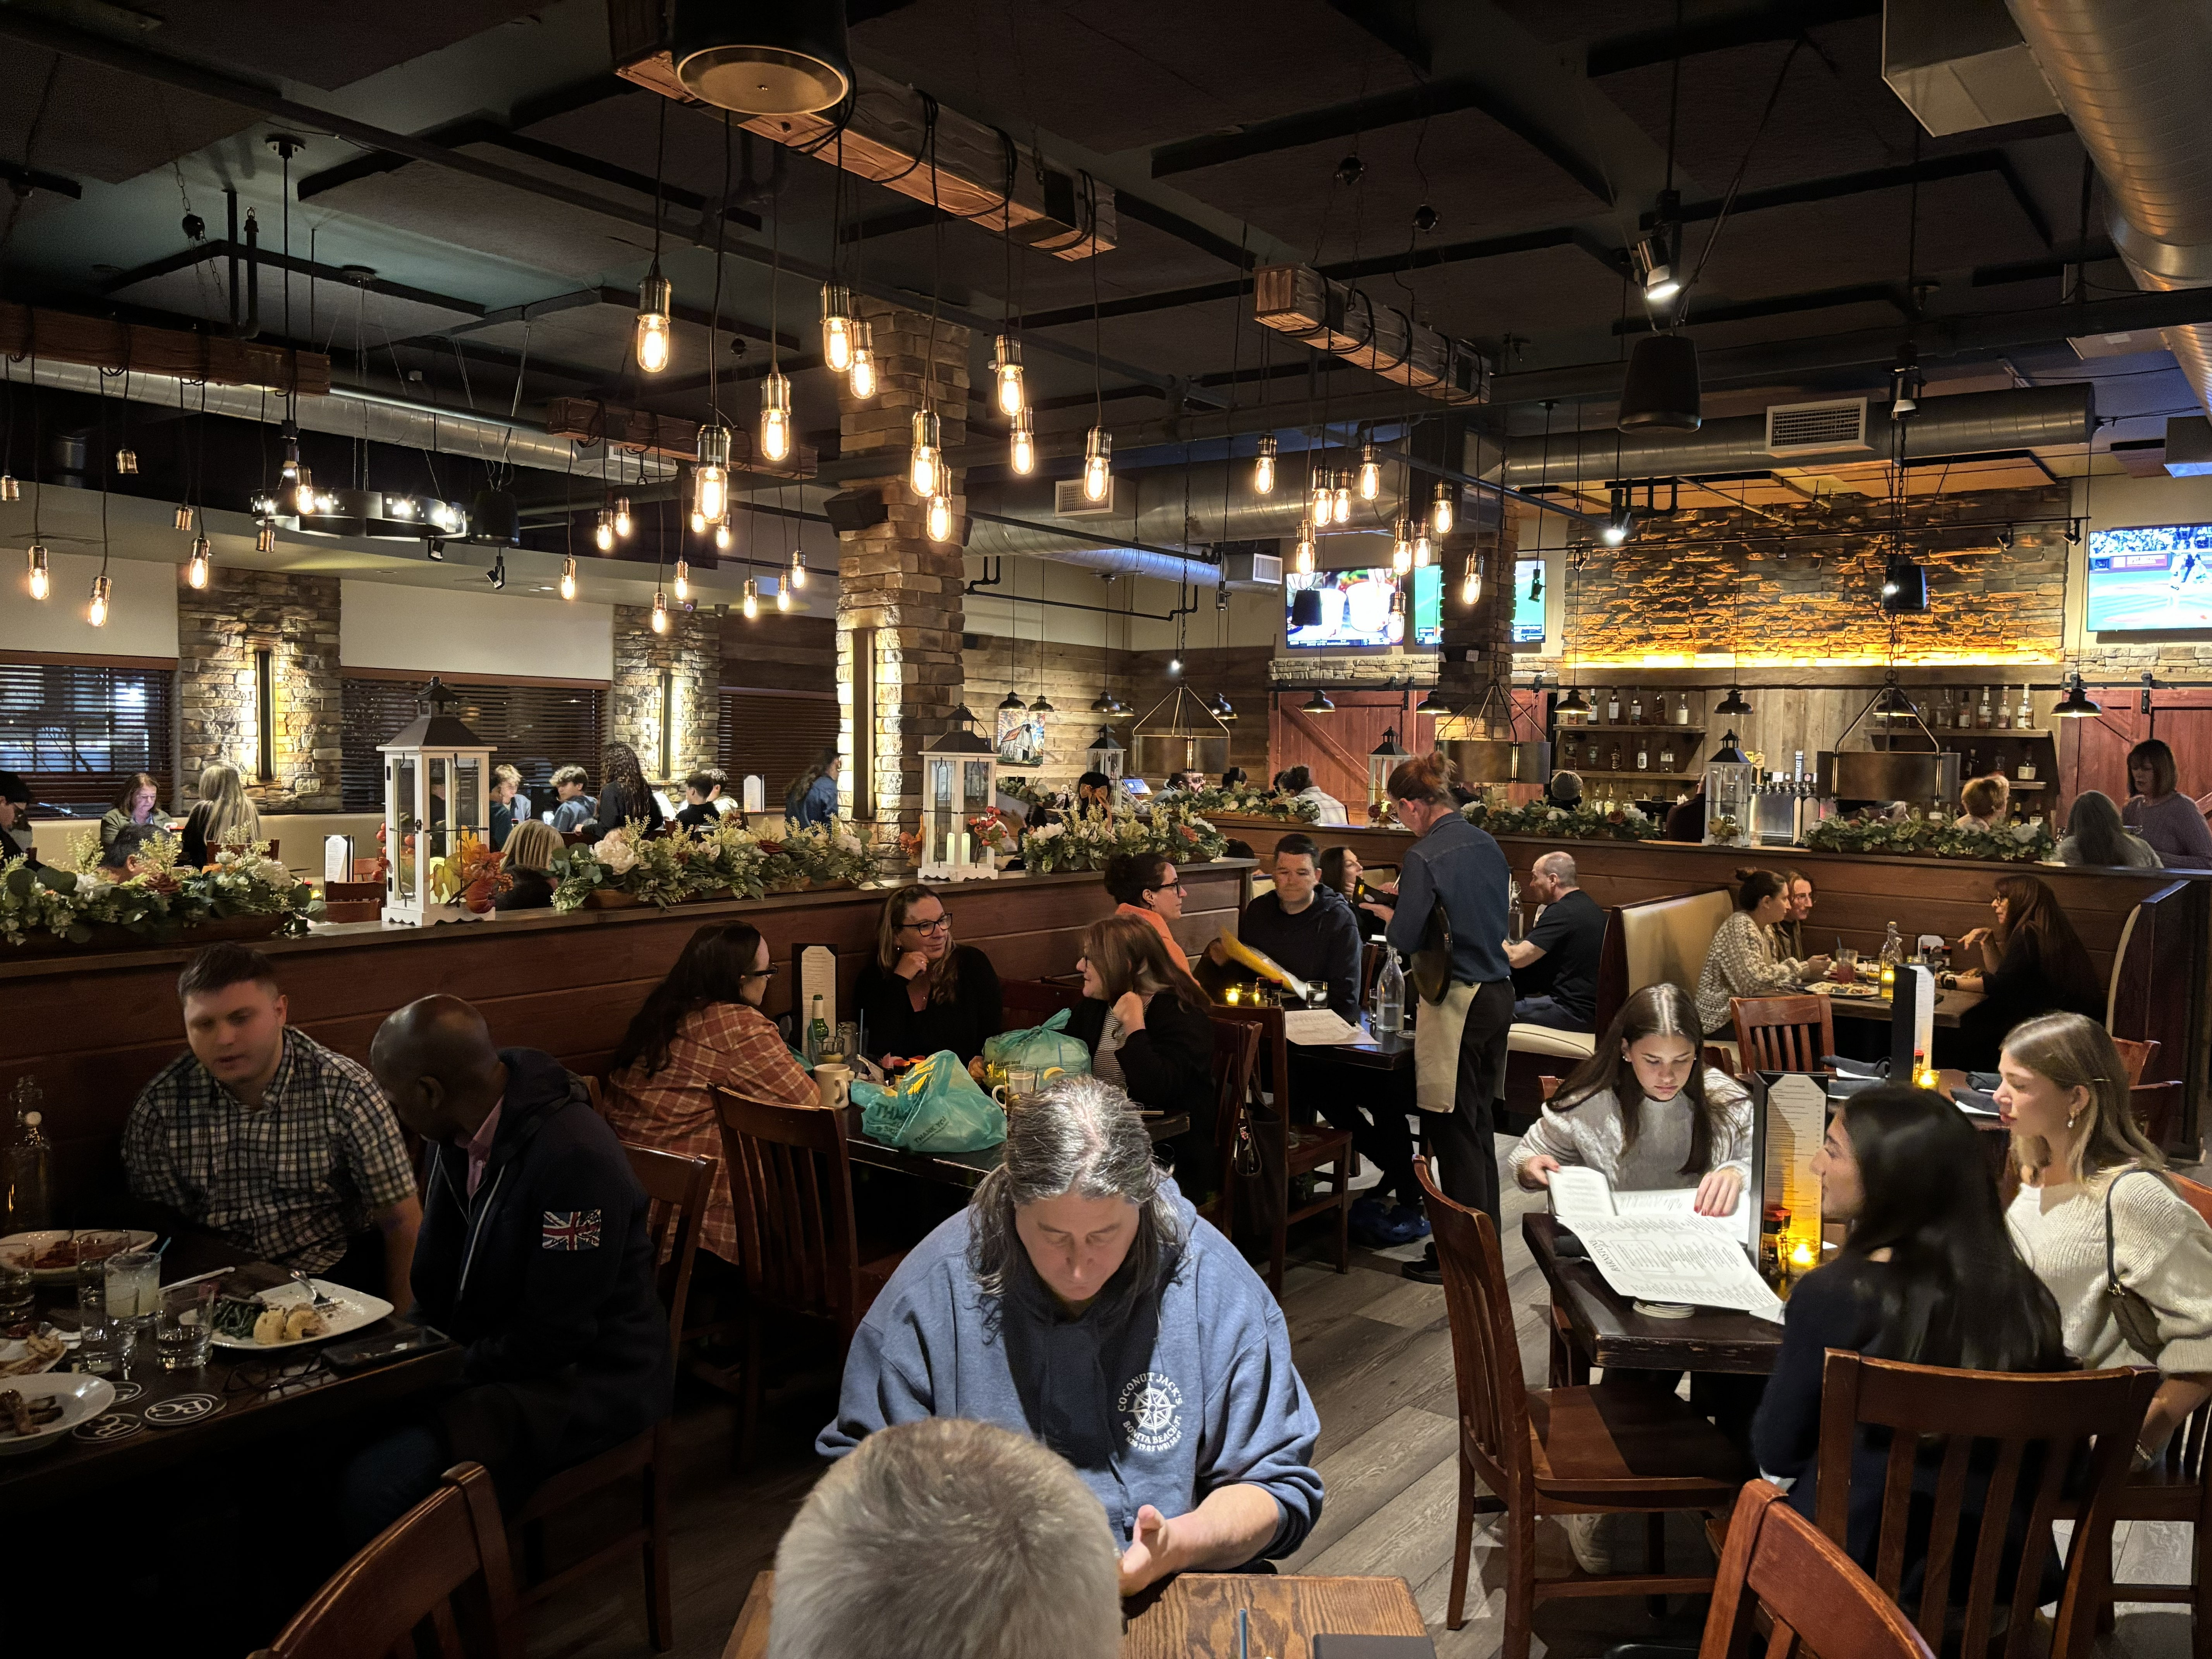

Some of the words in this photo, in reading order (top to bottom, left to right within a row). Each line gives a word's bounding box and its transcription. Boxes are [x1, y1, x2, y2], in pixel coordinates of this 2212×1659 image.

[914, 1126, 936, 1143] THANK
[1118, 1372, 1154, 1411] COCONUT
[1156, 1374, 1183, 1405] JACK'S
[1123, 1420, 1151, 1443] BONITA
